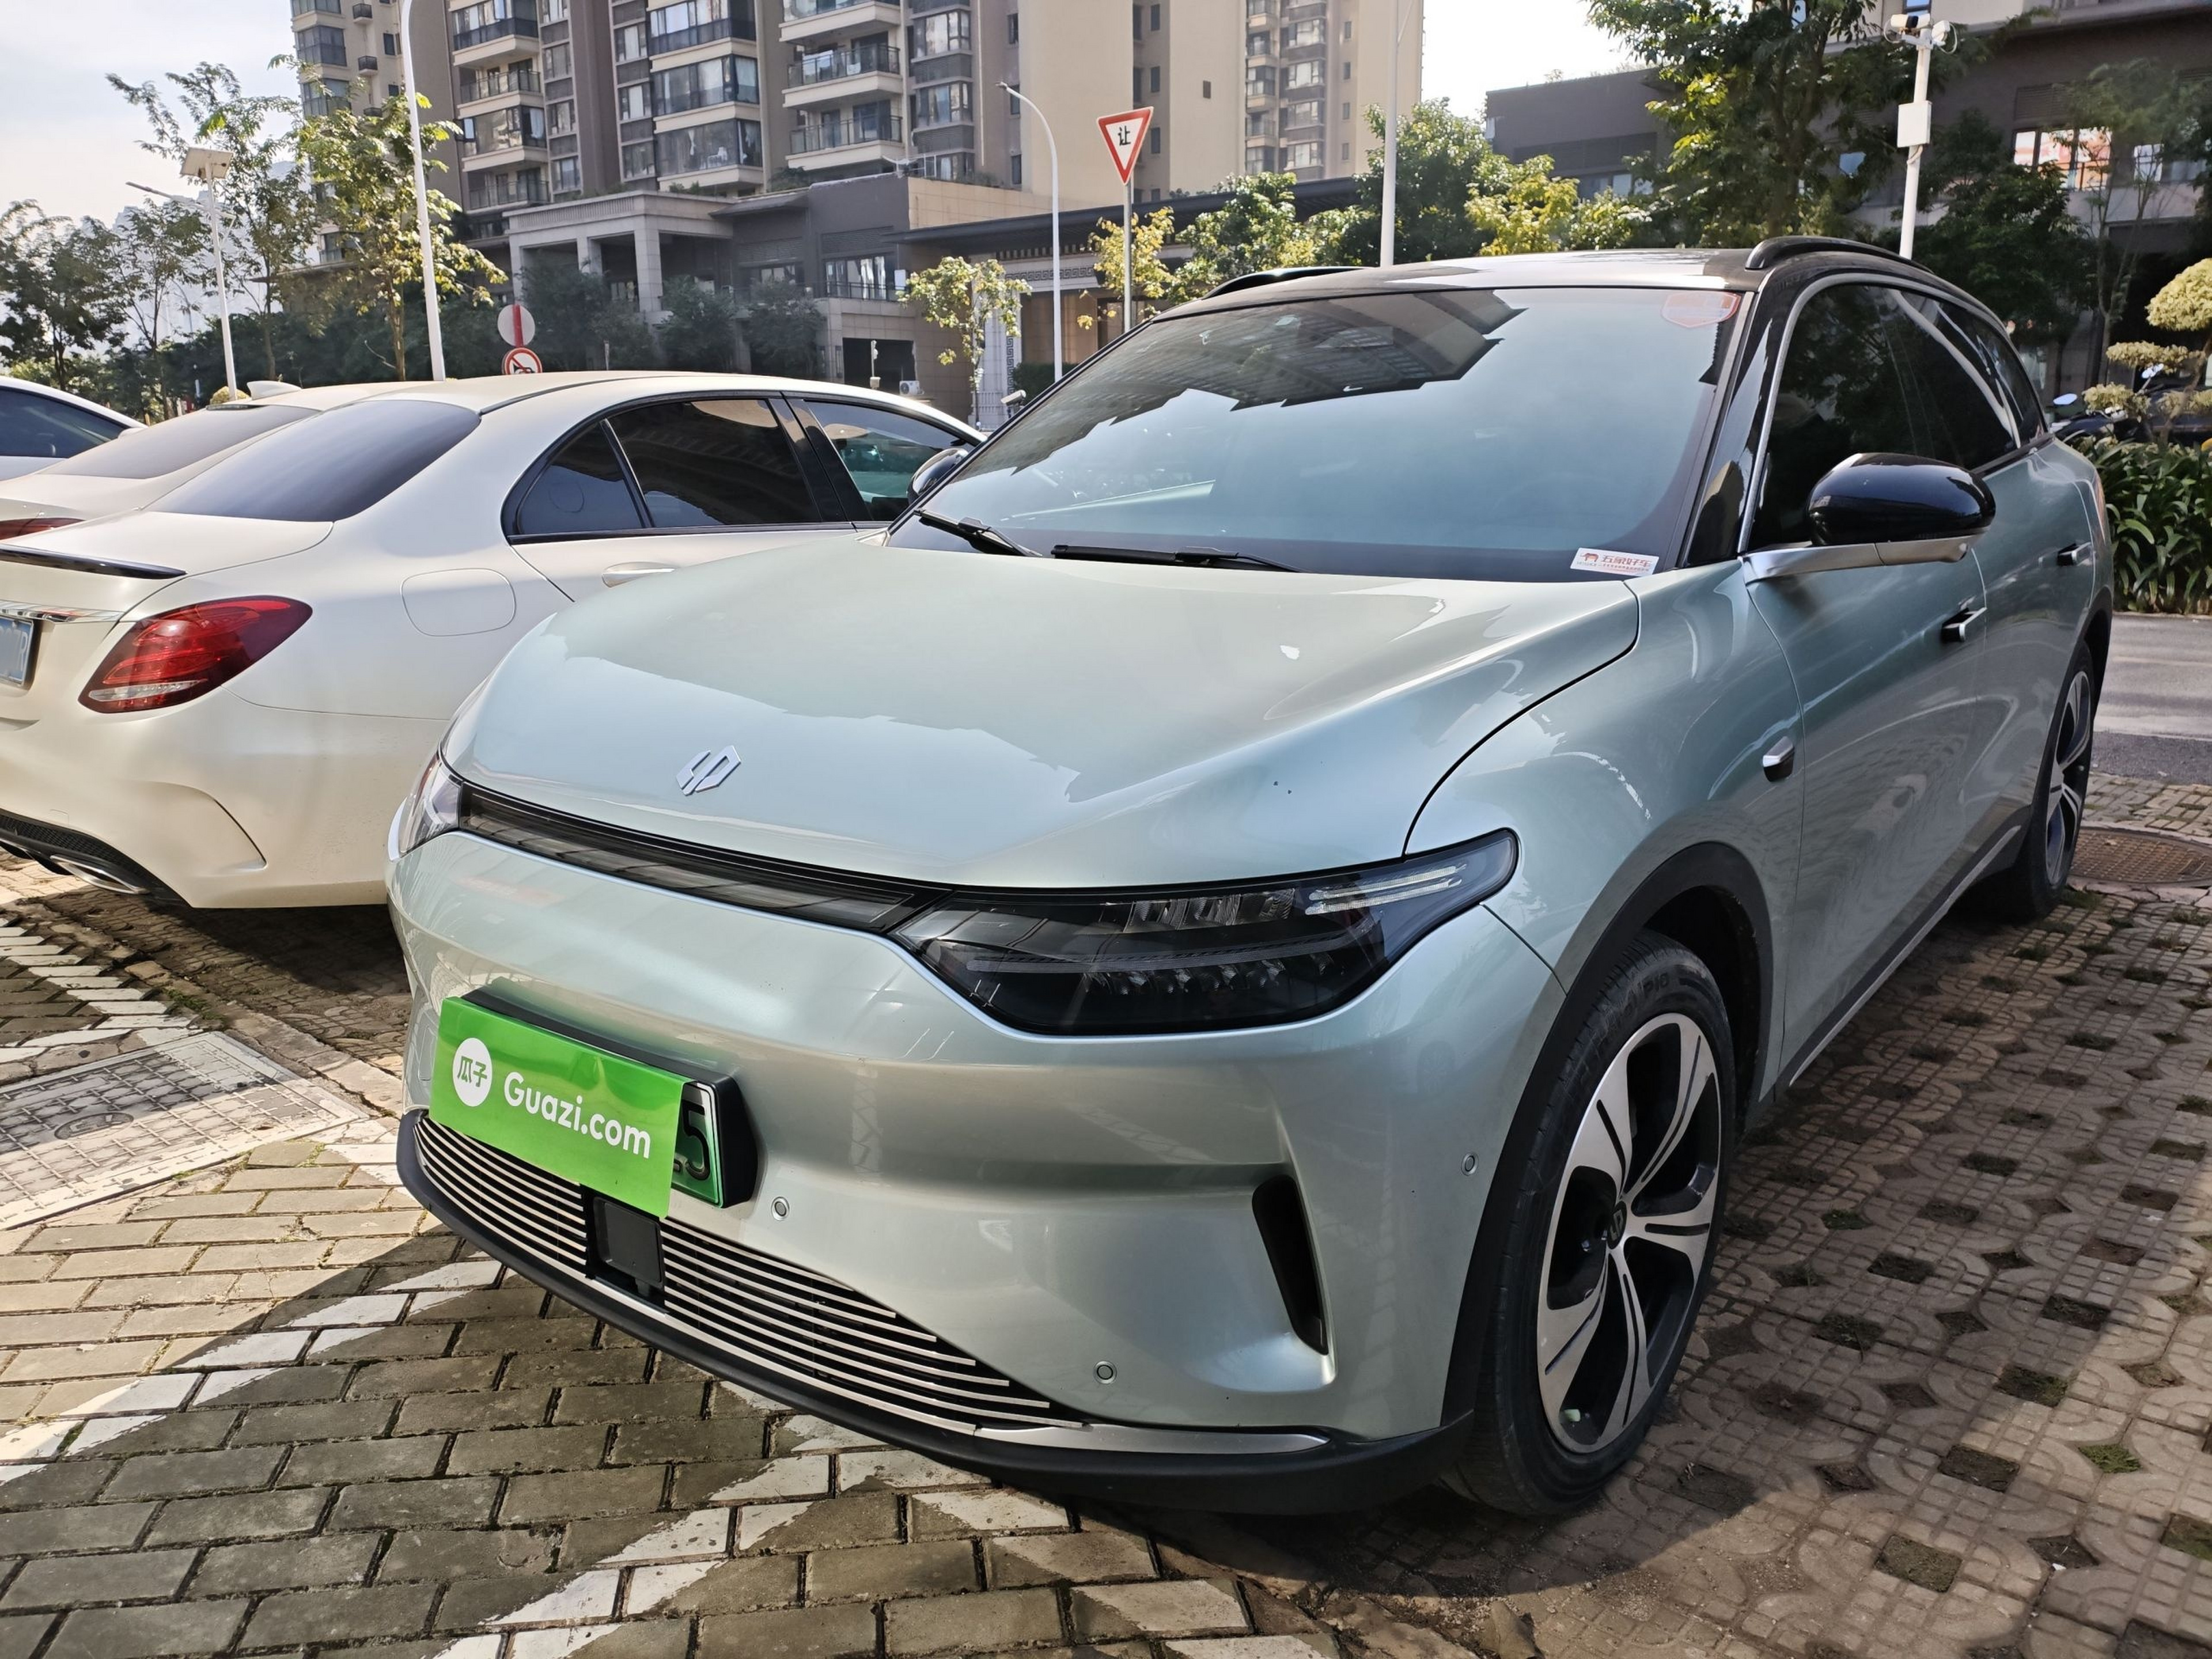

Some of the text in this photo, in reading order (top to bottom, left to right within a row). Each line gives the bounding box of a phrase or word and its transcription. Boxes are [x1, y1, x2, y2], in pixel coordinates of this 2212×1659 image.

[1118, 125, 1131, 146] 让
[457, 1055, 488, 1088] 瓜子
[503, 1071, 652, 1160] Guazi.com
